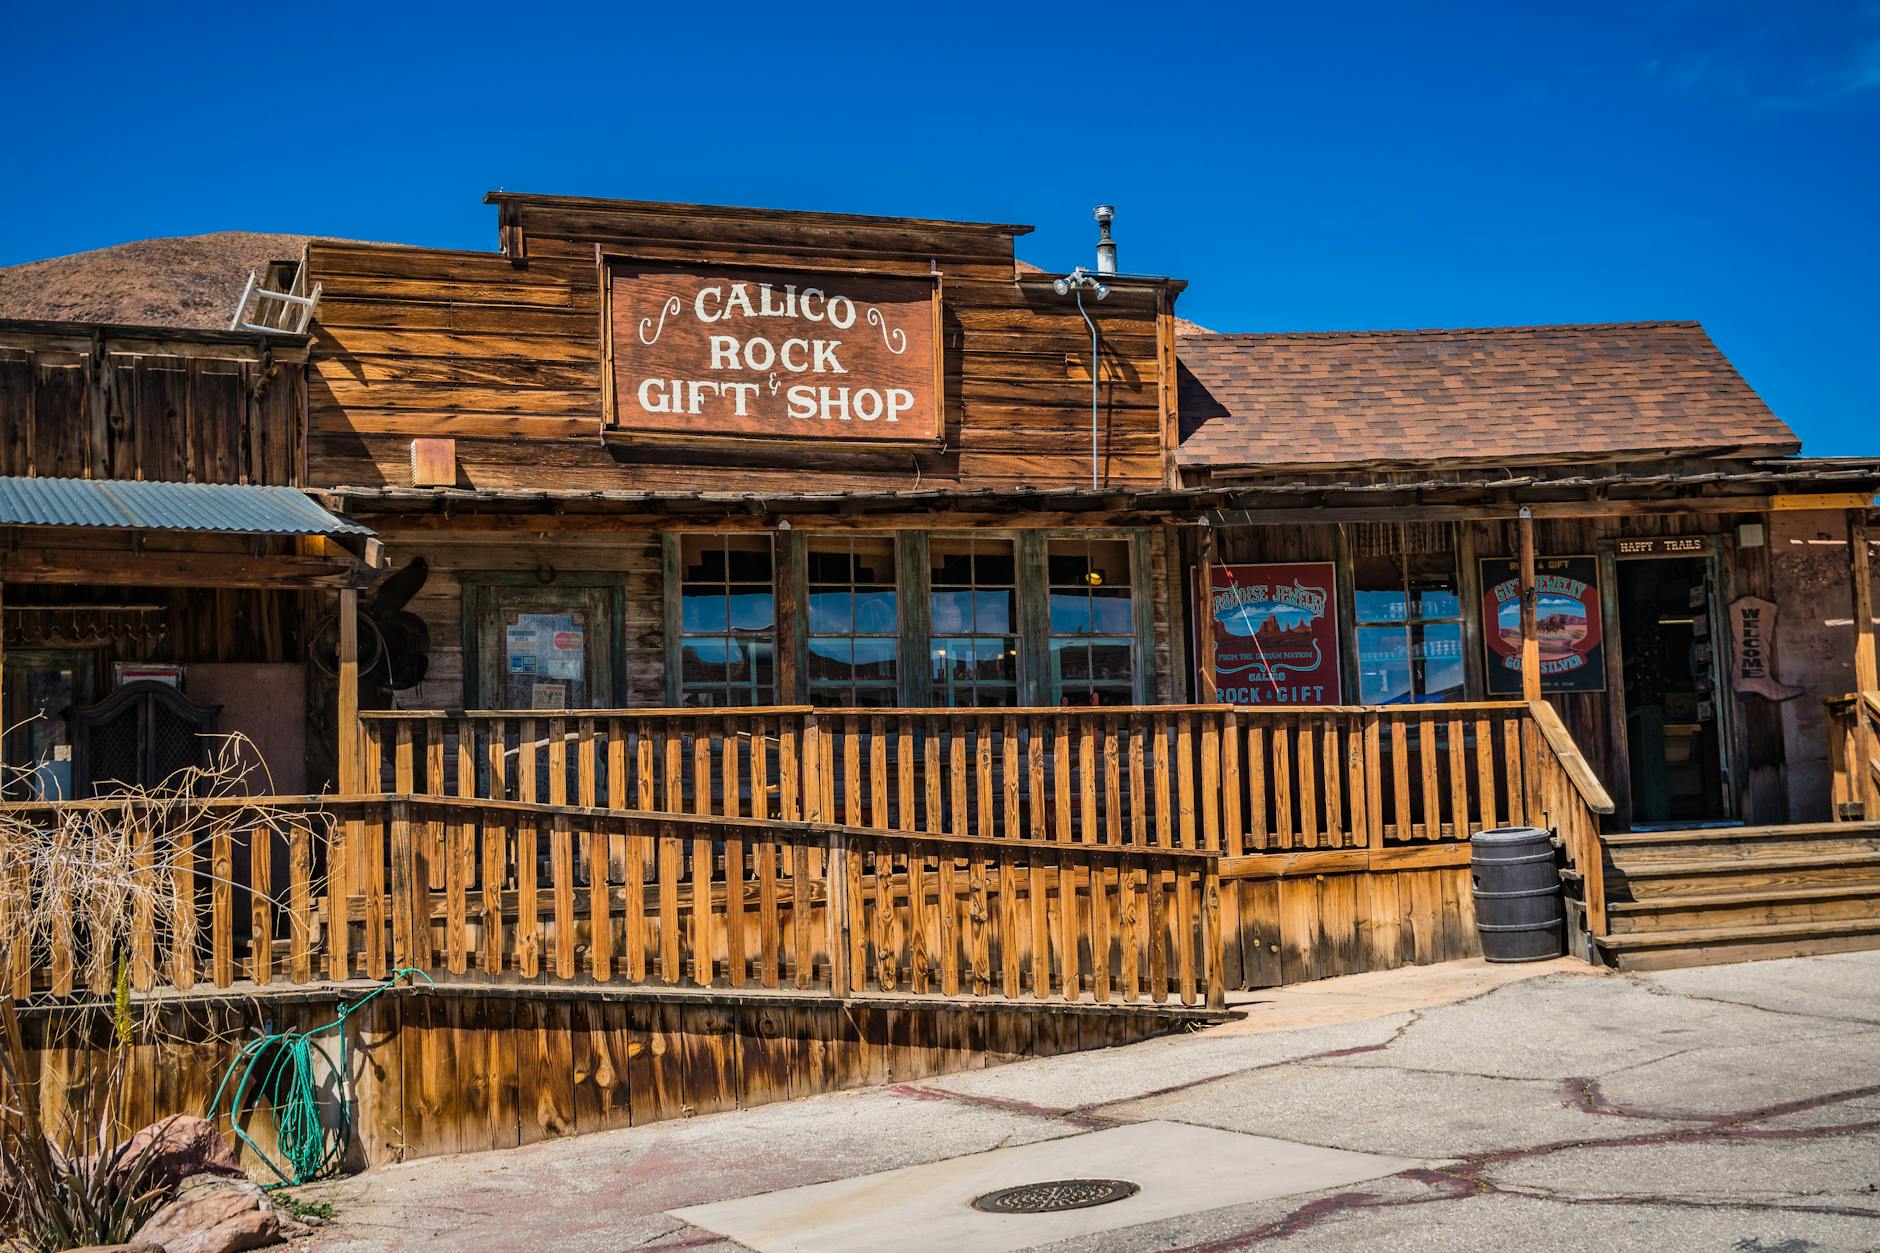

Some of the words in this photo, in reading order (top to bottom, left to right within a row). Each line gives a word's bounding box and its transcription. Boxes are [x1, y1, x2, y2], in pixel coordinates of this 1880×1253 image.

[694, 283, 857, 330] CALICO
[709, 335, 848, 374] ROCK
[637, 378, 760, 417] GIFT
[768, 371, 782, 396] &
[787, 385, 915, 422] SHOP
[1620, 541, 1653, 553] HAPPY
[1663, 539, 1701, 551] TRAILS
[1548, 560, 1570, 569] GIFT
[1272, 585, 1326, 618] JEWELRY
[1218, 653, 1238, 661] FROM
[1240, 652, 1253, 660] THE
[1283, 651, 1313, 659] NATION
[1741, 608, 1765, 678] WELCOME
[1541, 655, 1582, 673] SILVER
[1216, 688, 1261, 703] ROCK
[1276, 685, 1324, 702] GIFT
